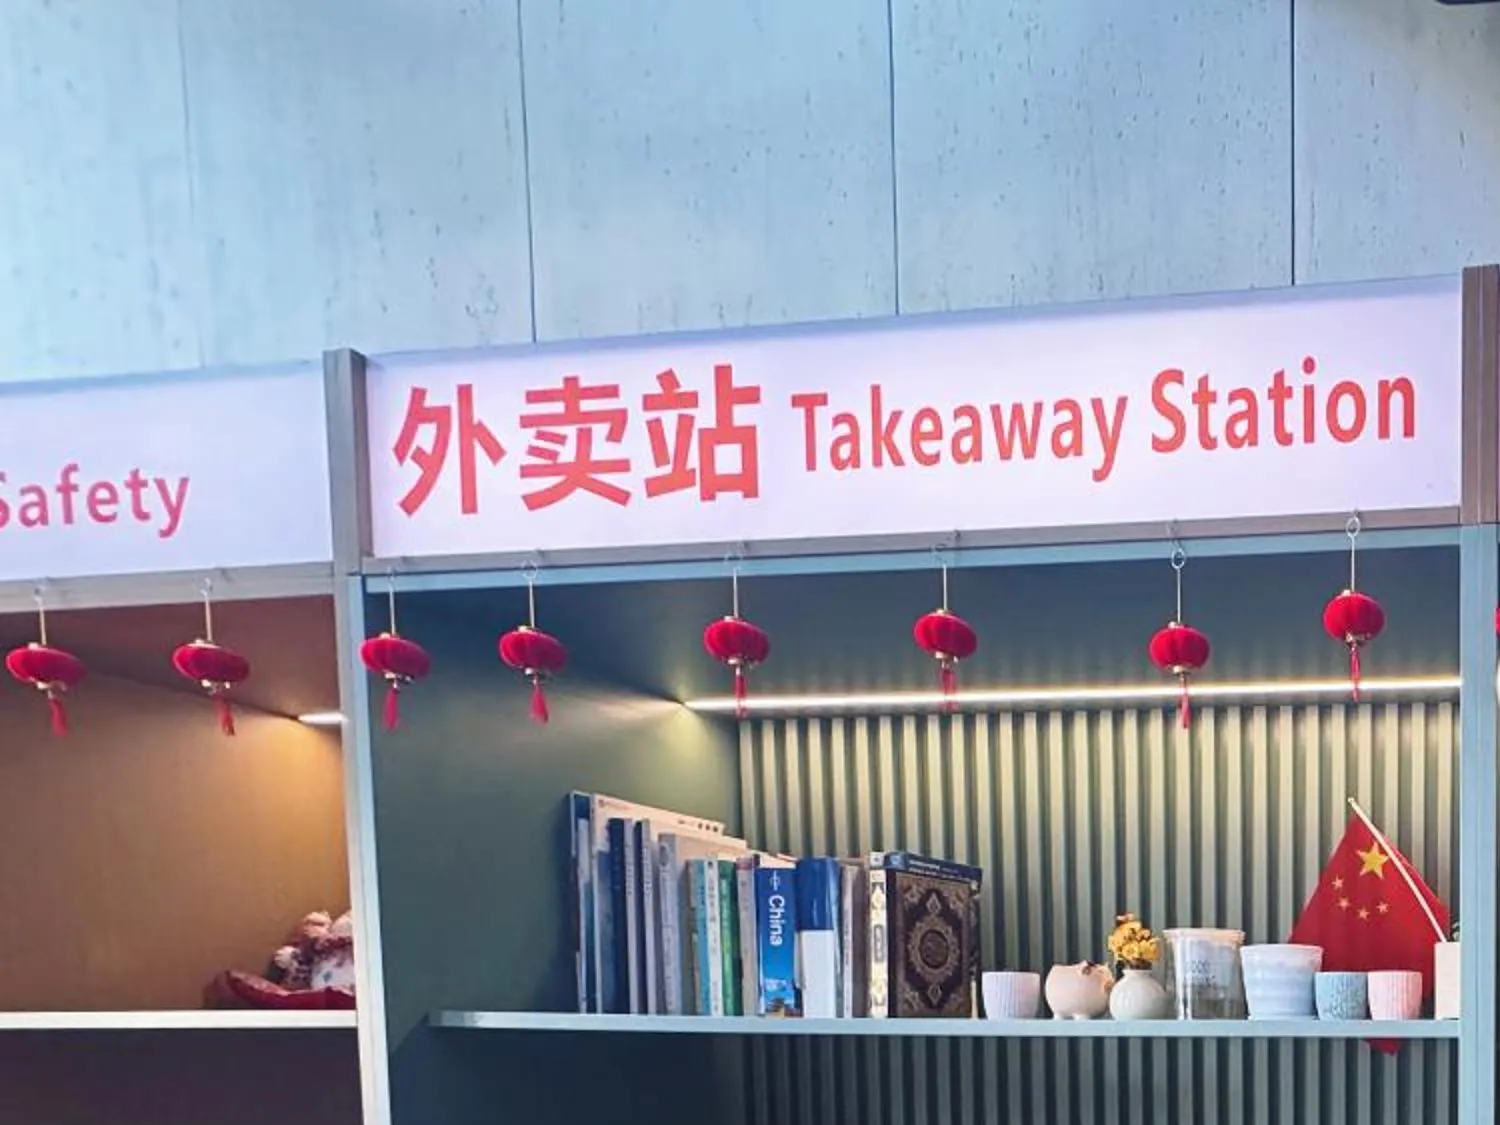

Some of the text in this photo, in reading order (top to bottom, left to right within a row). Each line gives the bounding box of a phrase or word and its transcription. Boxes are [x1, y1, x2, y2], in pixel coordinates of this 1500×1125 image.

[393, 364, 761, 517] 外卖站
[791, 355, 1416, 482] Takeaway Station
[768, 894, 785, 947] China
